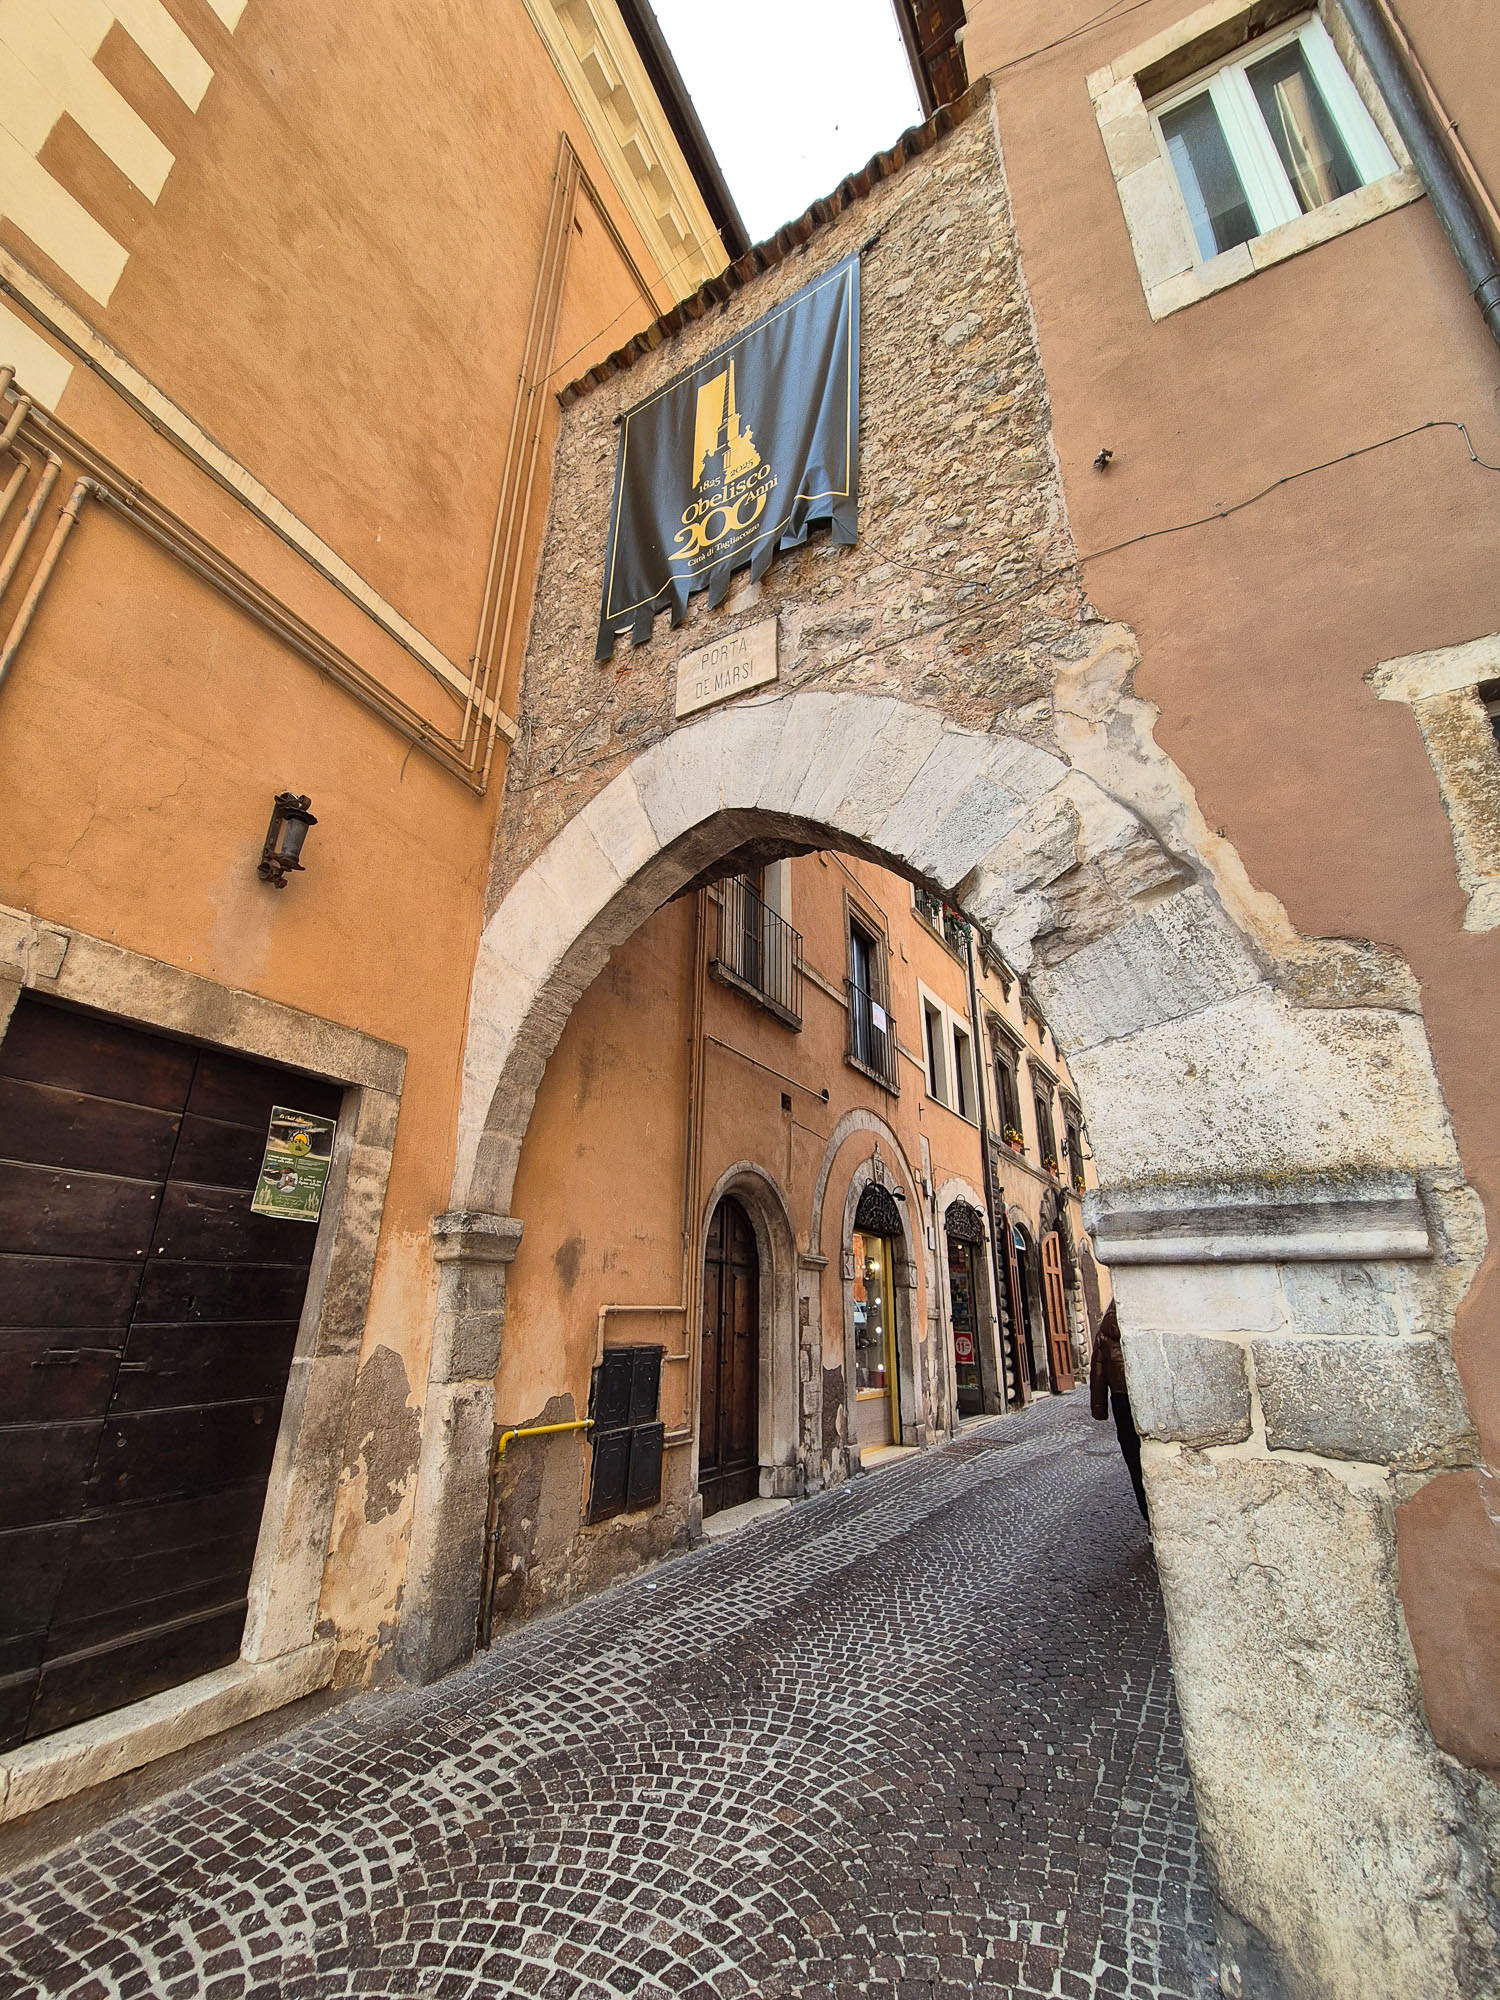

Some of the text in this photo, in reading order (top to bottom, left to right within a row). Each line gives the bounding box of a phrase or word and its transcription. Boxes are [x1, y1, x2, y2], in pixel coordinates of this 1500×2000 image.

[681, 463, 771, 525] Obelisco
[699, 458, 754, 493] 1825 2025
[667, 474, 779, 561] 200 Anni
[687, 523, 760, 567] Città di Tagliacozzo
[700, 637, 747, 670] PORTA
[695, 660, 753, 699] DE MARSI
